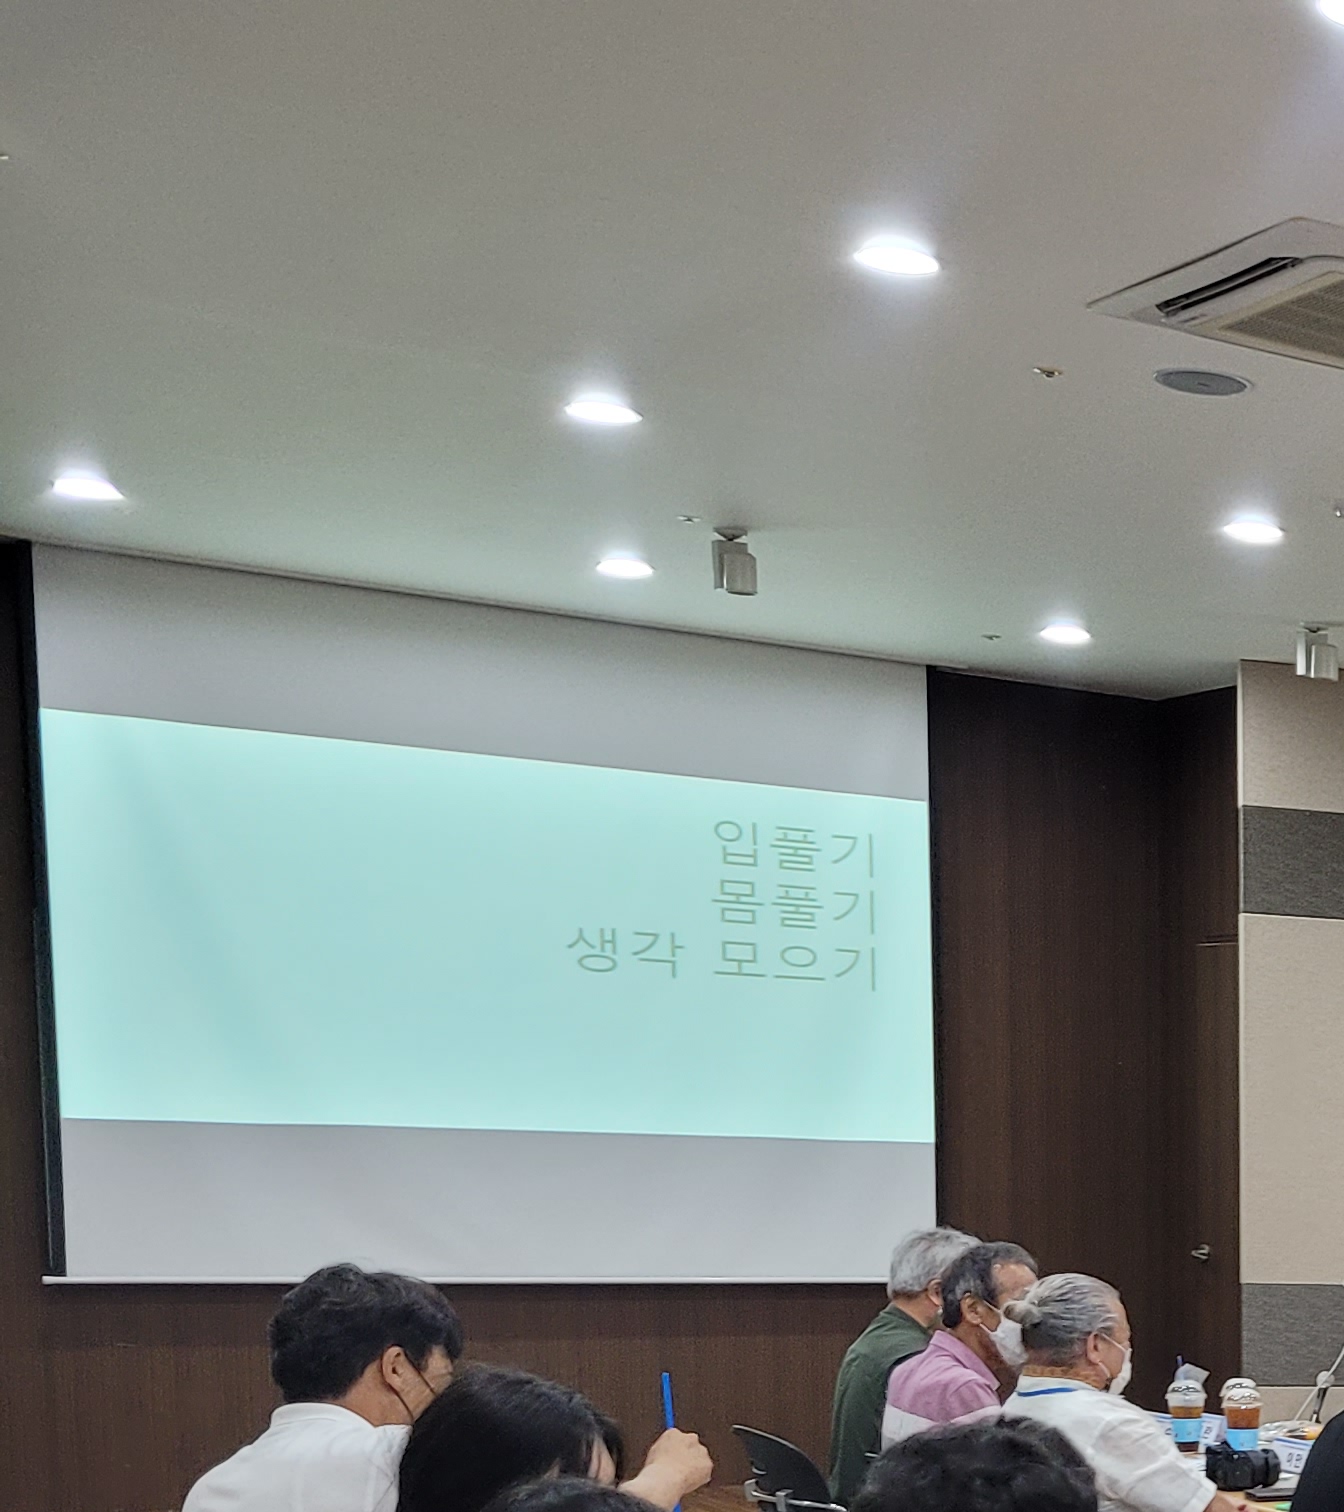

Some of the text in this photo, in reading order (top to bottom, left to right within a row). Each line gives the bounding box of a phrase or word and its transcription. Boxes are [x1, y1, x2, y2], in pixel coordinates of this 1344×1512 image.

[713, 820, 875, 879] 입풀기
[710, 878, 875, 936] 몸풀기
[566, 927, 876, 992] 생각 모으기
